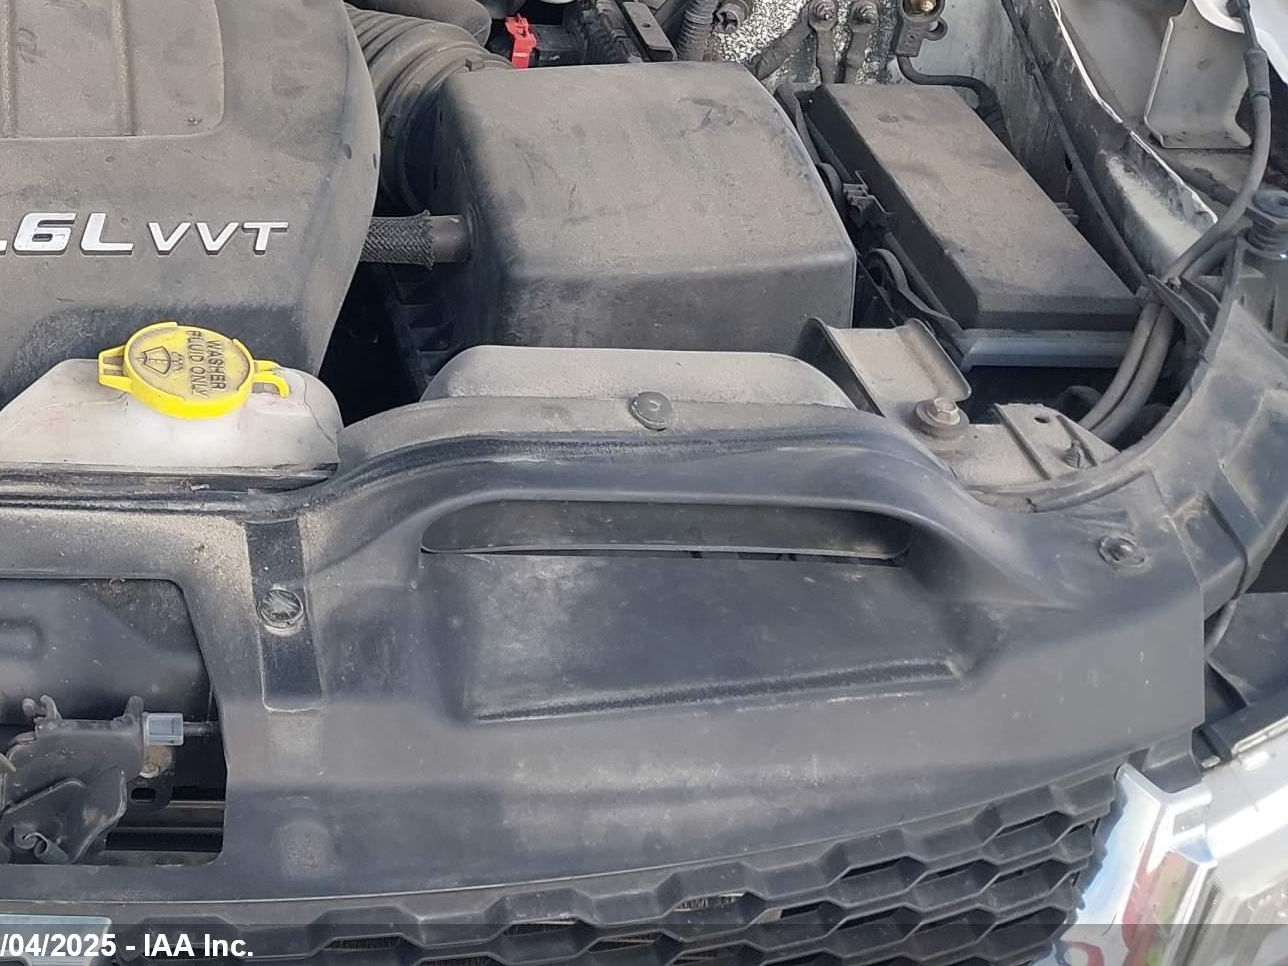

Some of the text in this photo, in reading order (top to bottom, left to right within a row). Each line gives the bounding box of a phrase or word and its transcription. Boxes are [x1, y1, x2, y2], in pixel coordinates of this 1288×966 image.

[147, 221, 289, 255] VVT
[187, 330, 209, 398] FLUID ONLY
[207, 339, 227, 391] WASHER
